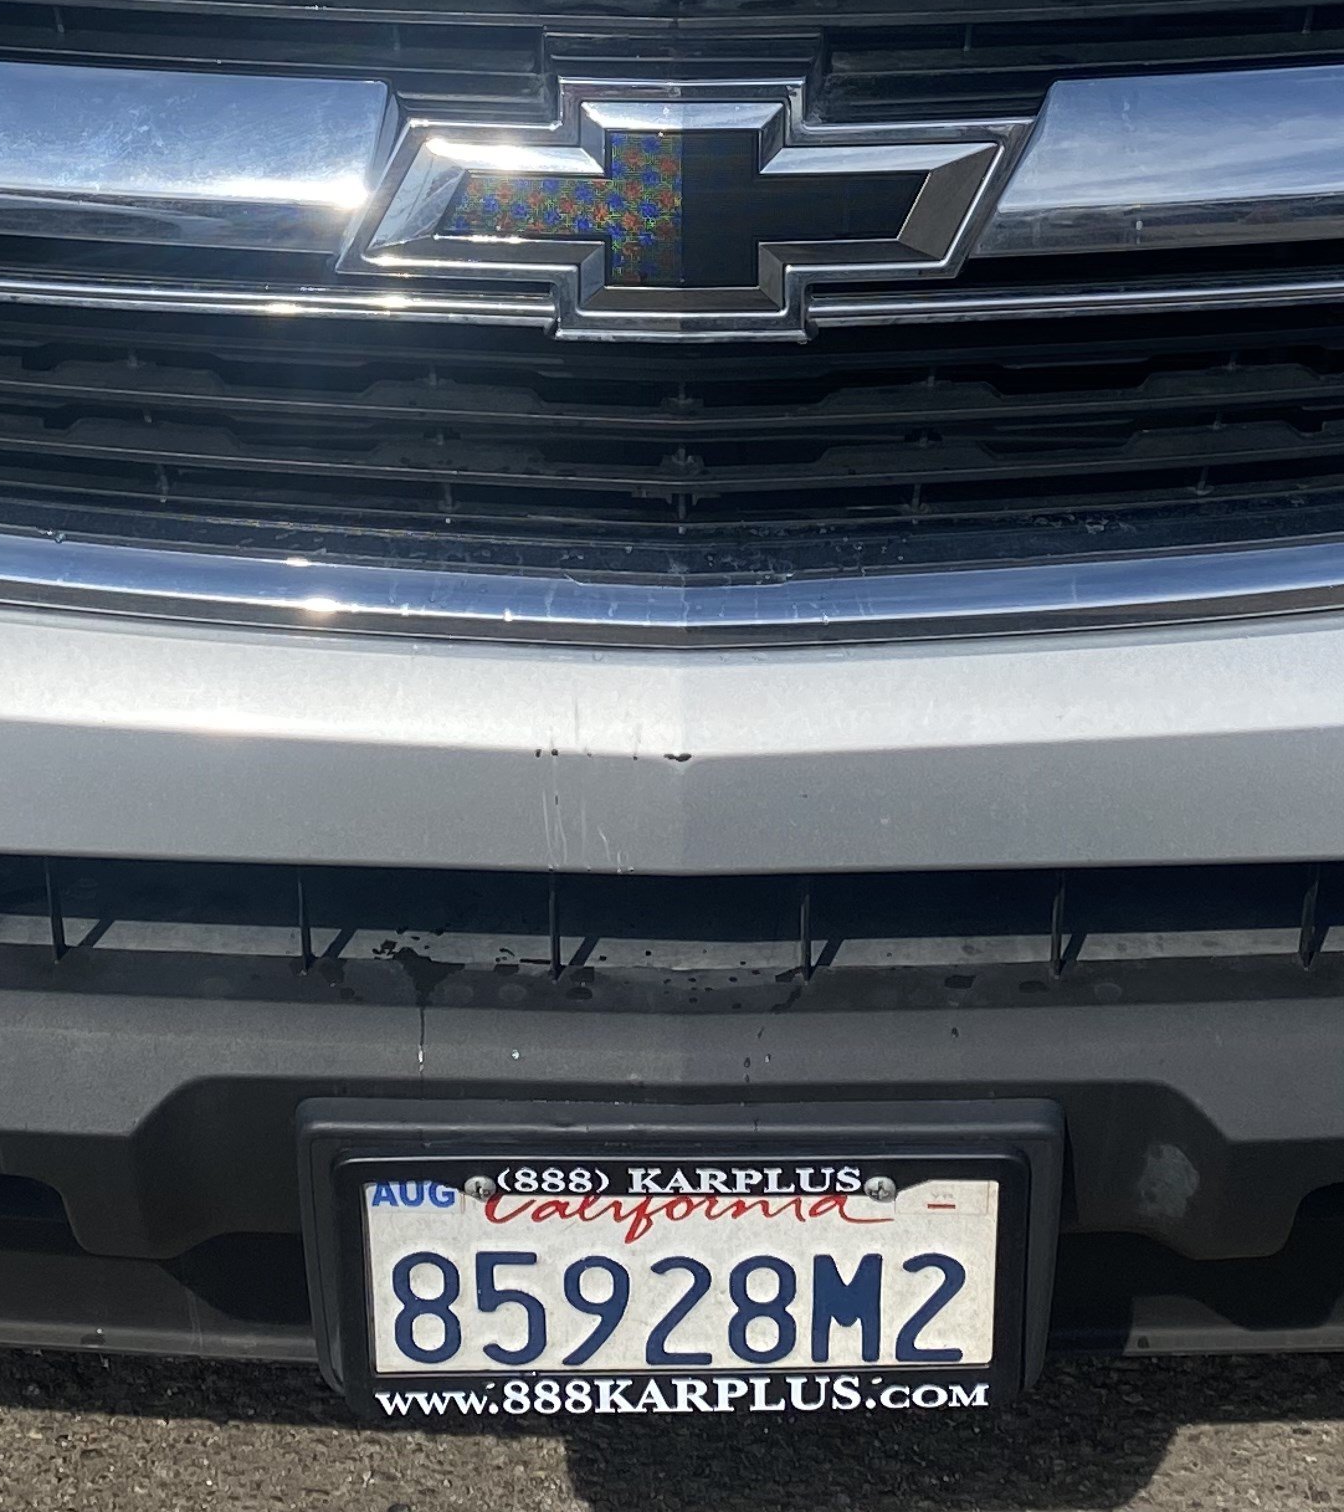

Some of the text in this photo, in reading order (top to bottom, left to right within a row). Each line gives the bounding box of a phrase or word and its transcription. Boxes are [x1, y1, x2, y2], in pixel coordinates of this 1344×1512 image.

[372, 1180, 456, 1208] AUG
[497, 1166, 862, 1194] (888) KARPLUS
[391, 1250, 967, 1366] 85928M2
